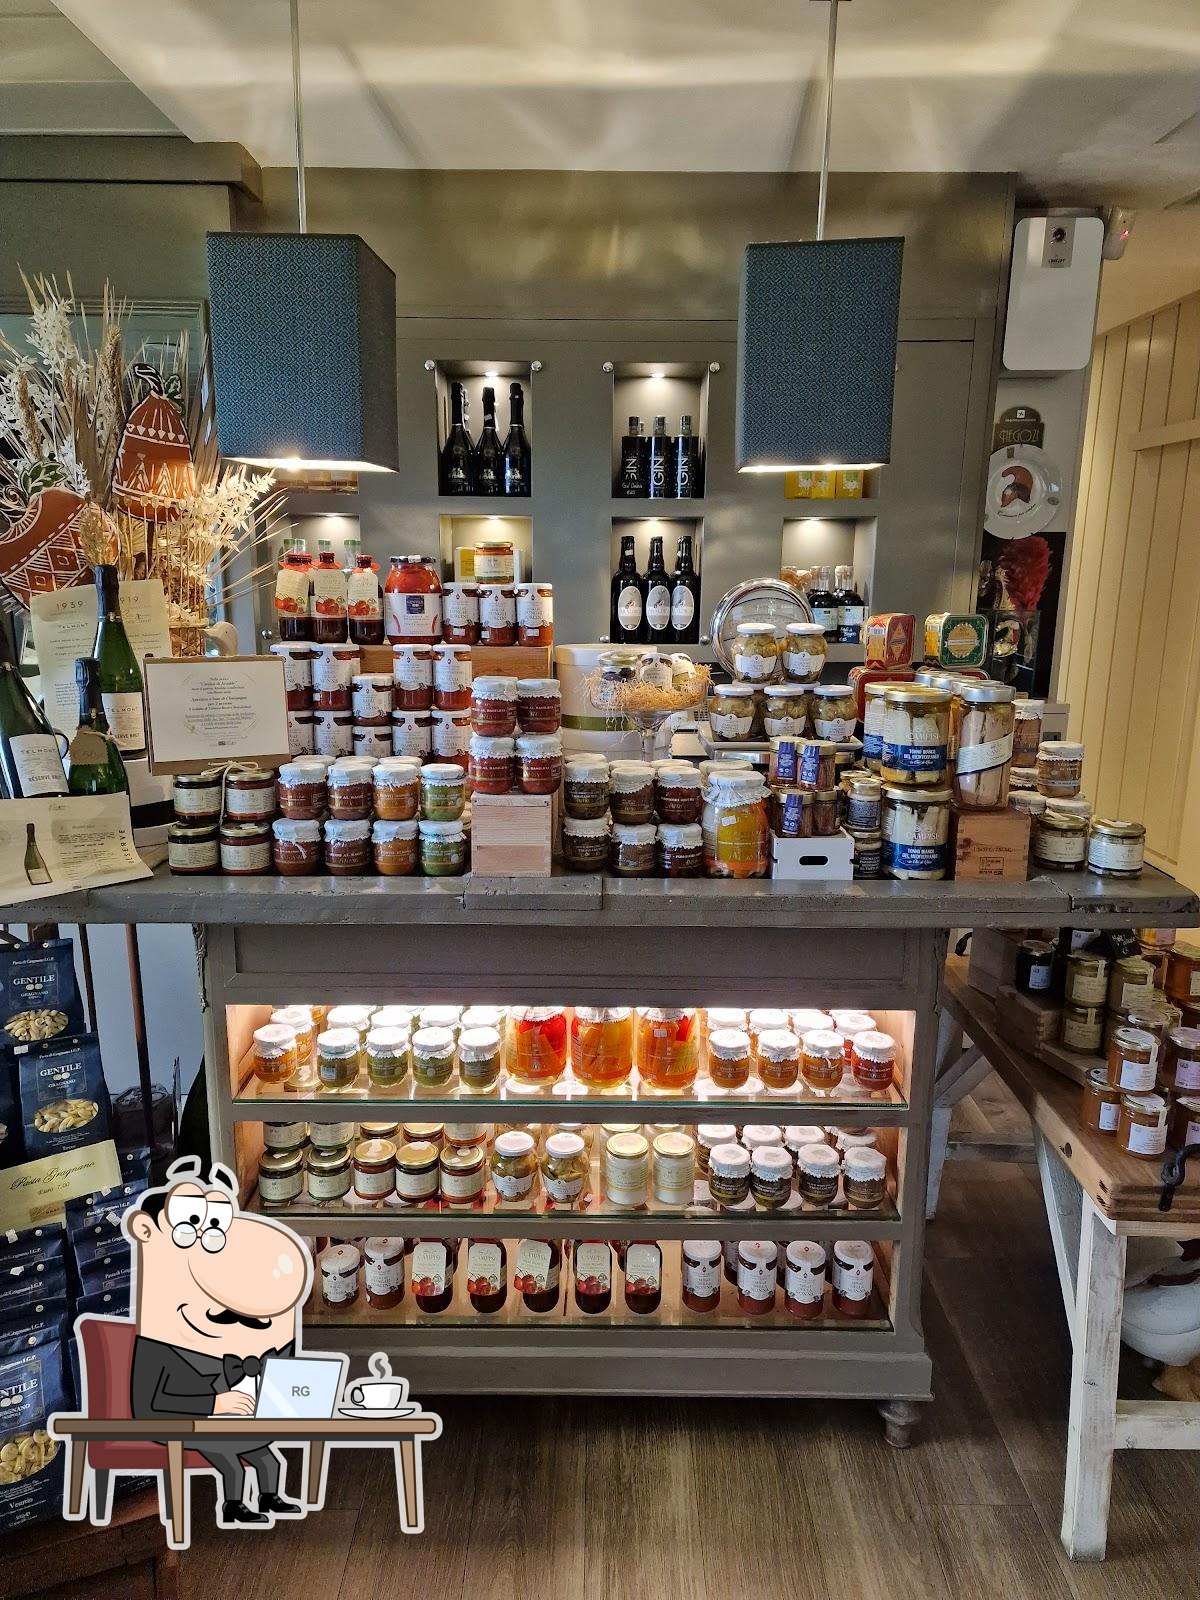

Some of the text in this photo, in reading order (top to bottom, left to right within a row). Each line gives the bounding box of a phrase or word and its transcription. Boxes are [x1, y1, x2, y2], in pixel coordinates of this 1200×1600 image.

[652, 455, 665, 486] GIN
[680, 455, 689, 486] GIN
[56, 600, 84, 610] 1939
[905, 732, 940, 740] CAMPISI
[905, 832, 938, 840] CAMPISI
[13, 974, 56, 986] GENTILE
[40, 1062, 82, 1077] GENTILE
[48, 1079, 76, 1088] GRAGNANO
[9, 1161, 95, 1190] Pasta Gragnano
[0, 1378, 39, 1398] NTILE
